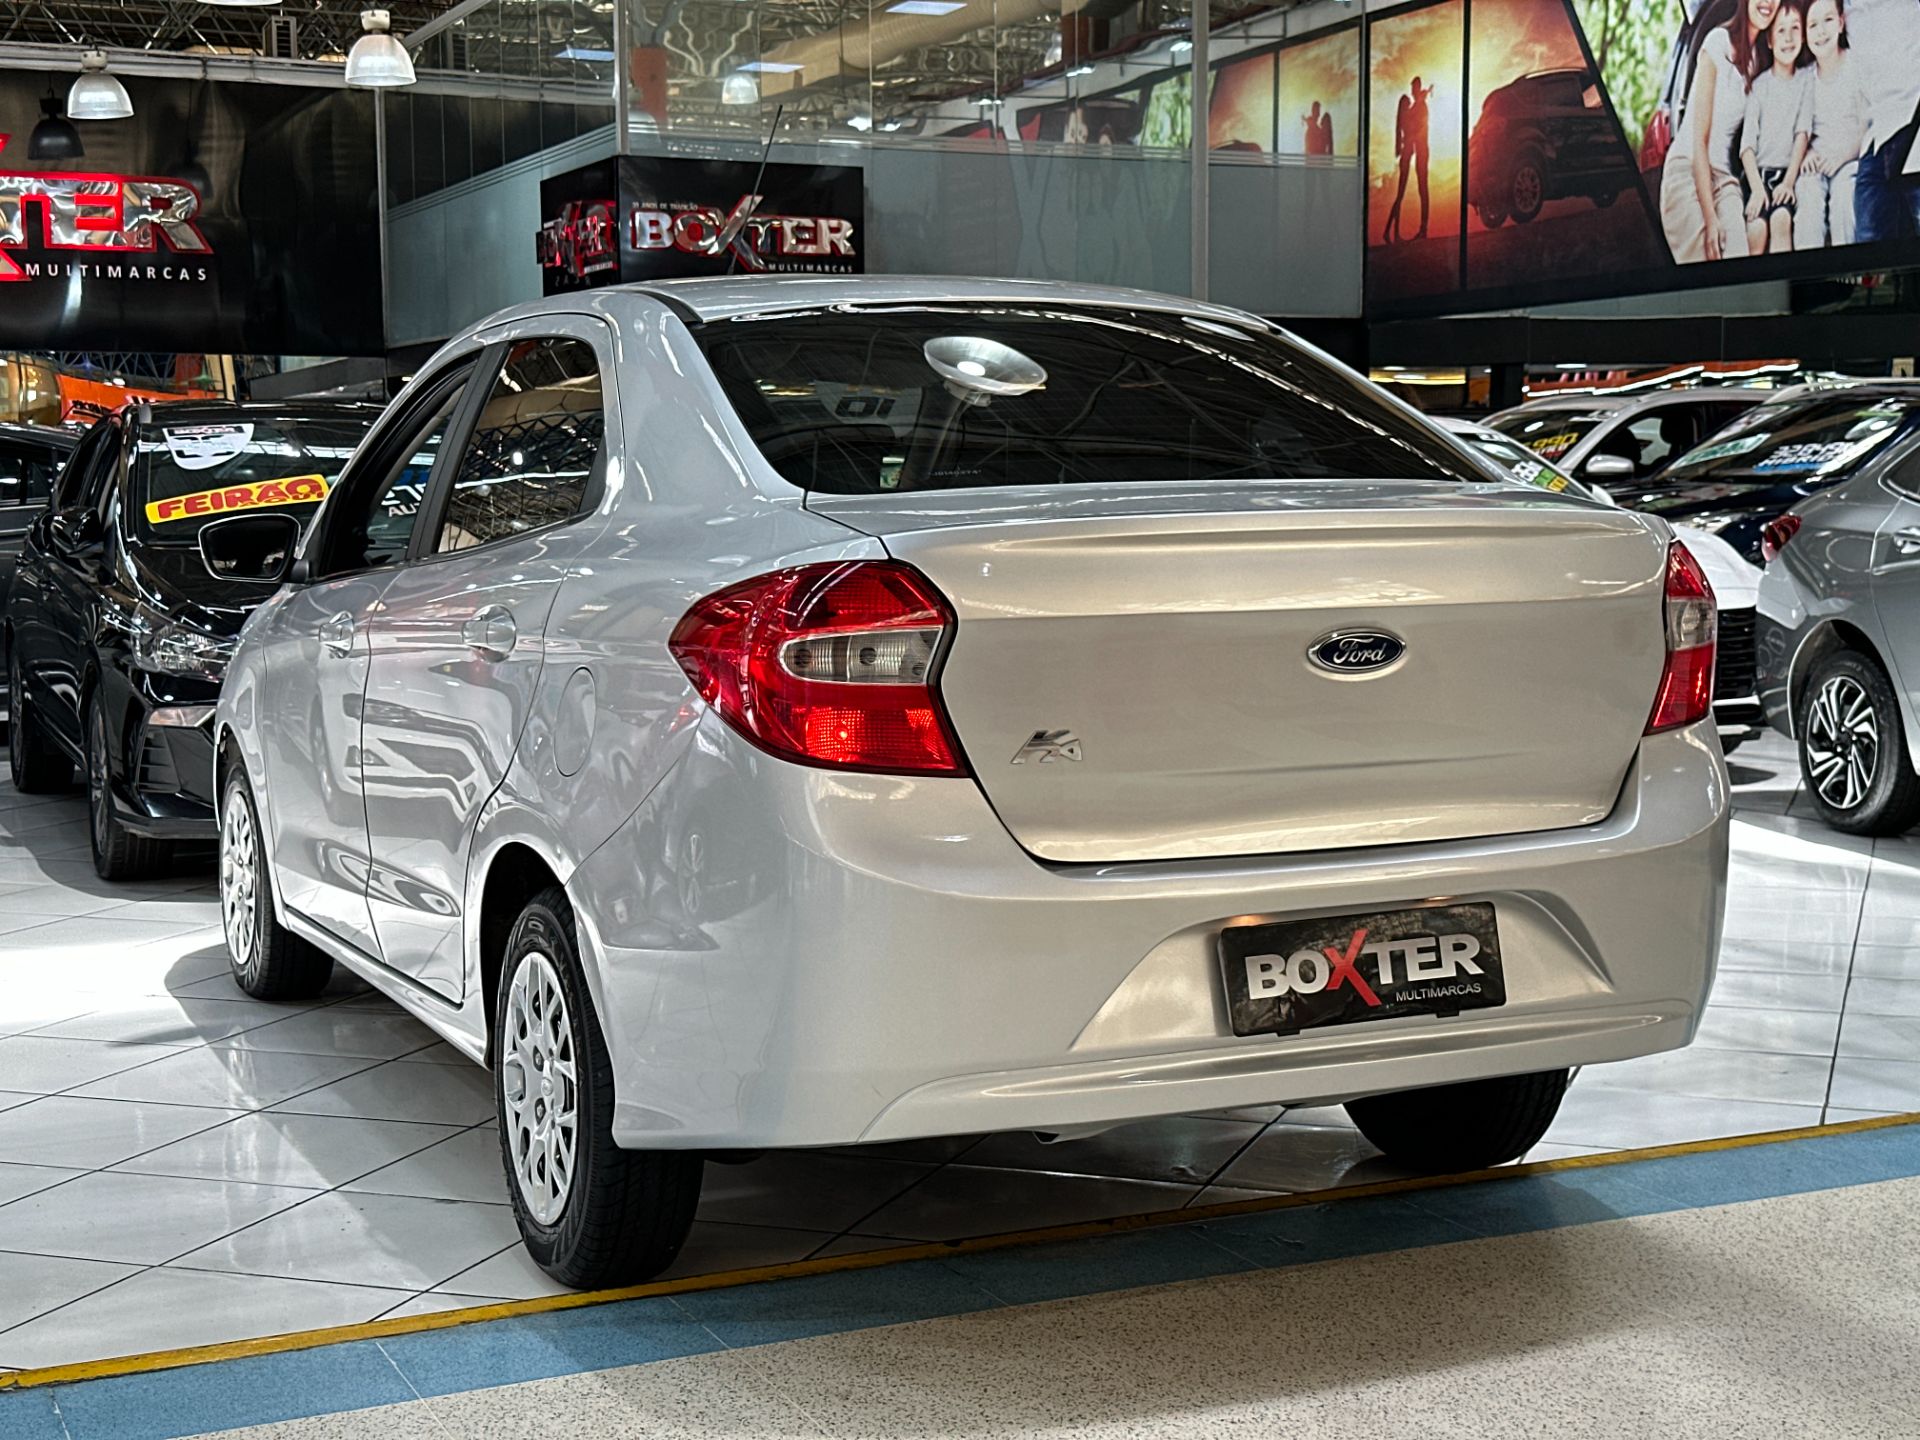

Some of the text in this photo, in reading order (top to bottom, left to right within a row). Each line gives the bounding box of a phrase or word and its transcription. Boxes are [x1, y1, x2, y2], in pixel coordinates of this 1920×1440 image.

[630, 195, 856, 271] BOXTER
[25, 263, 207, 281] MULTIMARCAS
[768, 263, 854, 274] MULTIMARCAS
[157, 477, 325, 519] FEIRÃO
[1333, 637, 1386, 664] Ford
[1245, 928, 1485, 1007] BOXTER
[1396, 982, 1482, 1003] MULTIMARCAS
